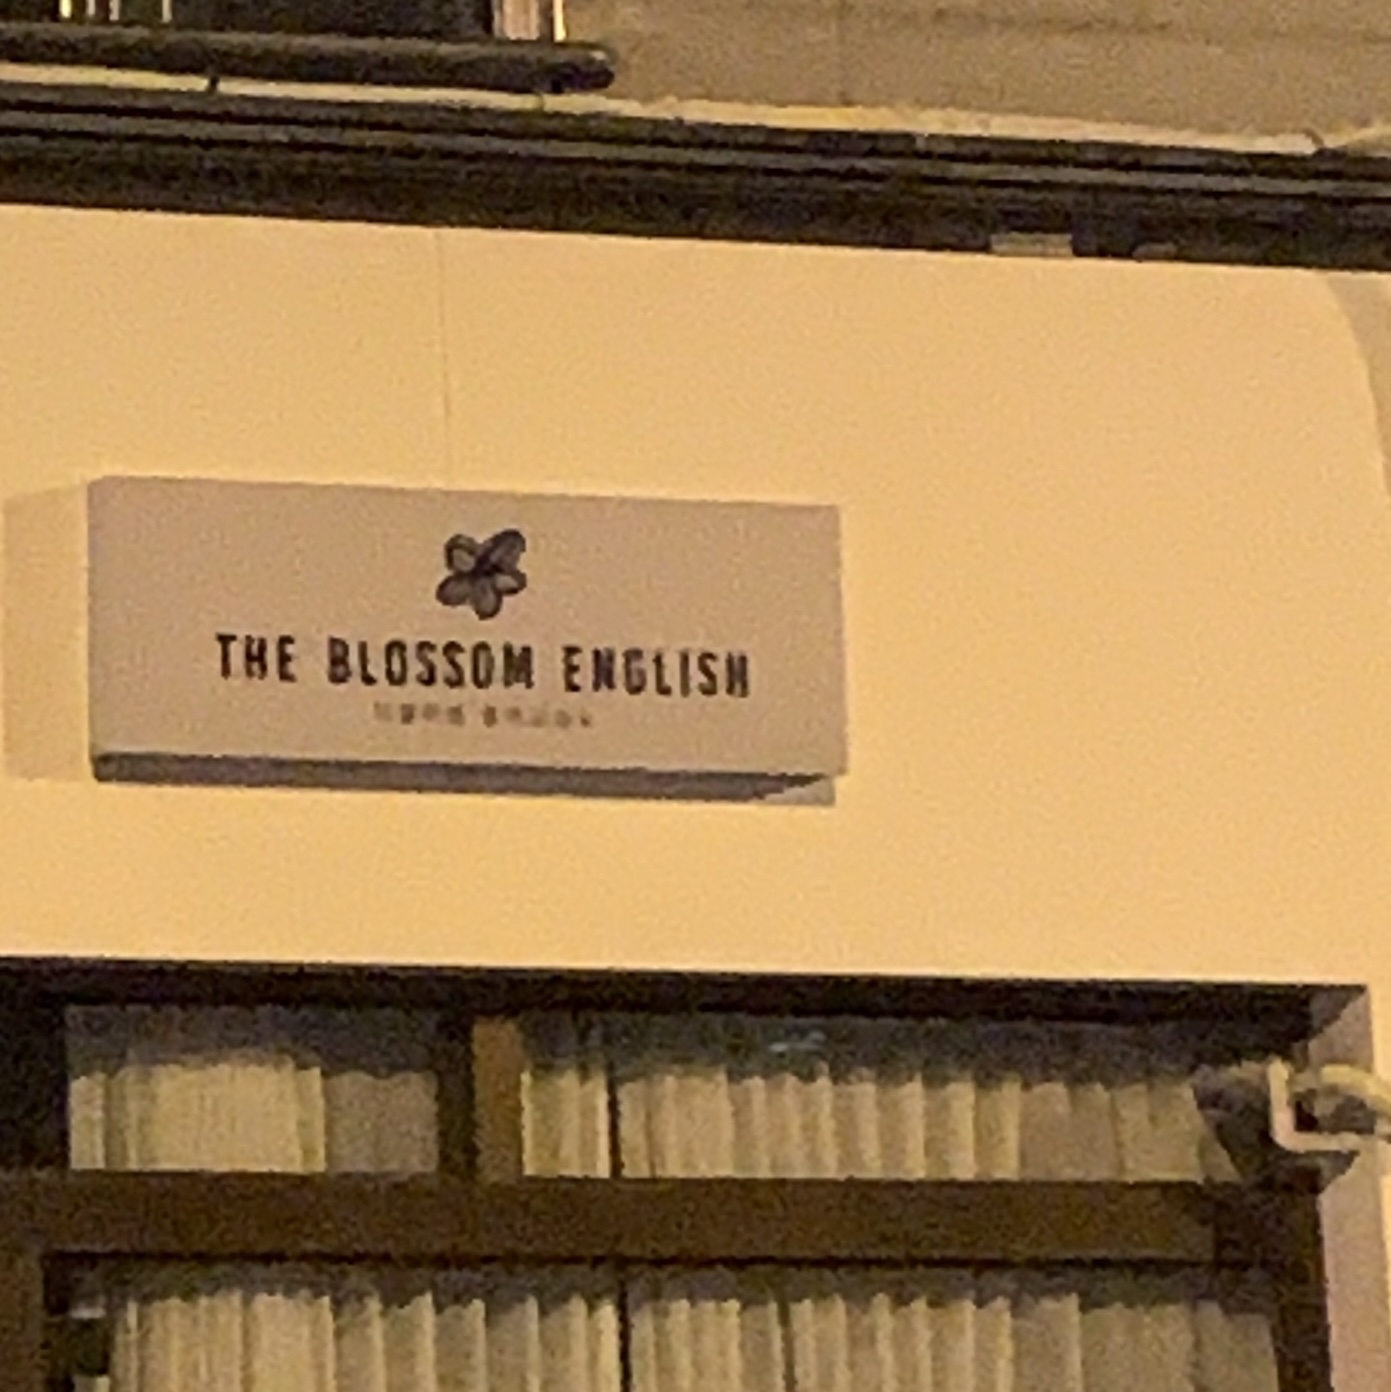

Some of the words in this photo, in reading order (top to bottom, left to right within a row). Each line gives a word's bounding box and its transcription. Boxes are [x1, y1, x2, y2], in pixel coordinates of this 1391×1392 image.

[215, 633, 298, 684] THE
[326, 637, 535, 690] BLOSSOM
[561, 644, 750, 699] ENGLISH
